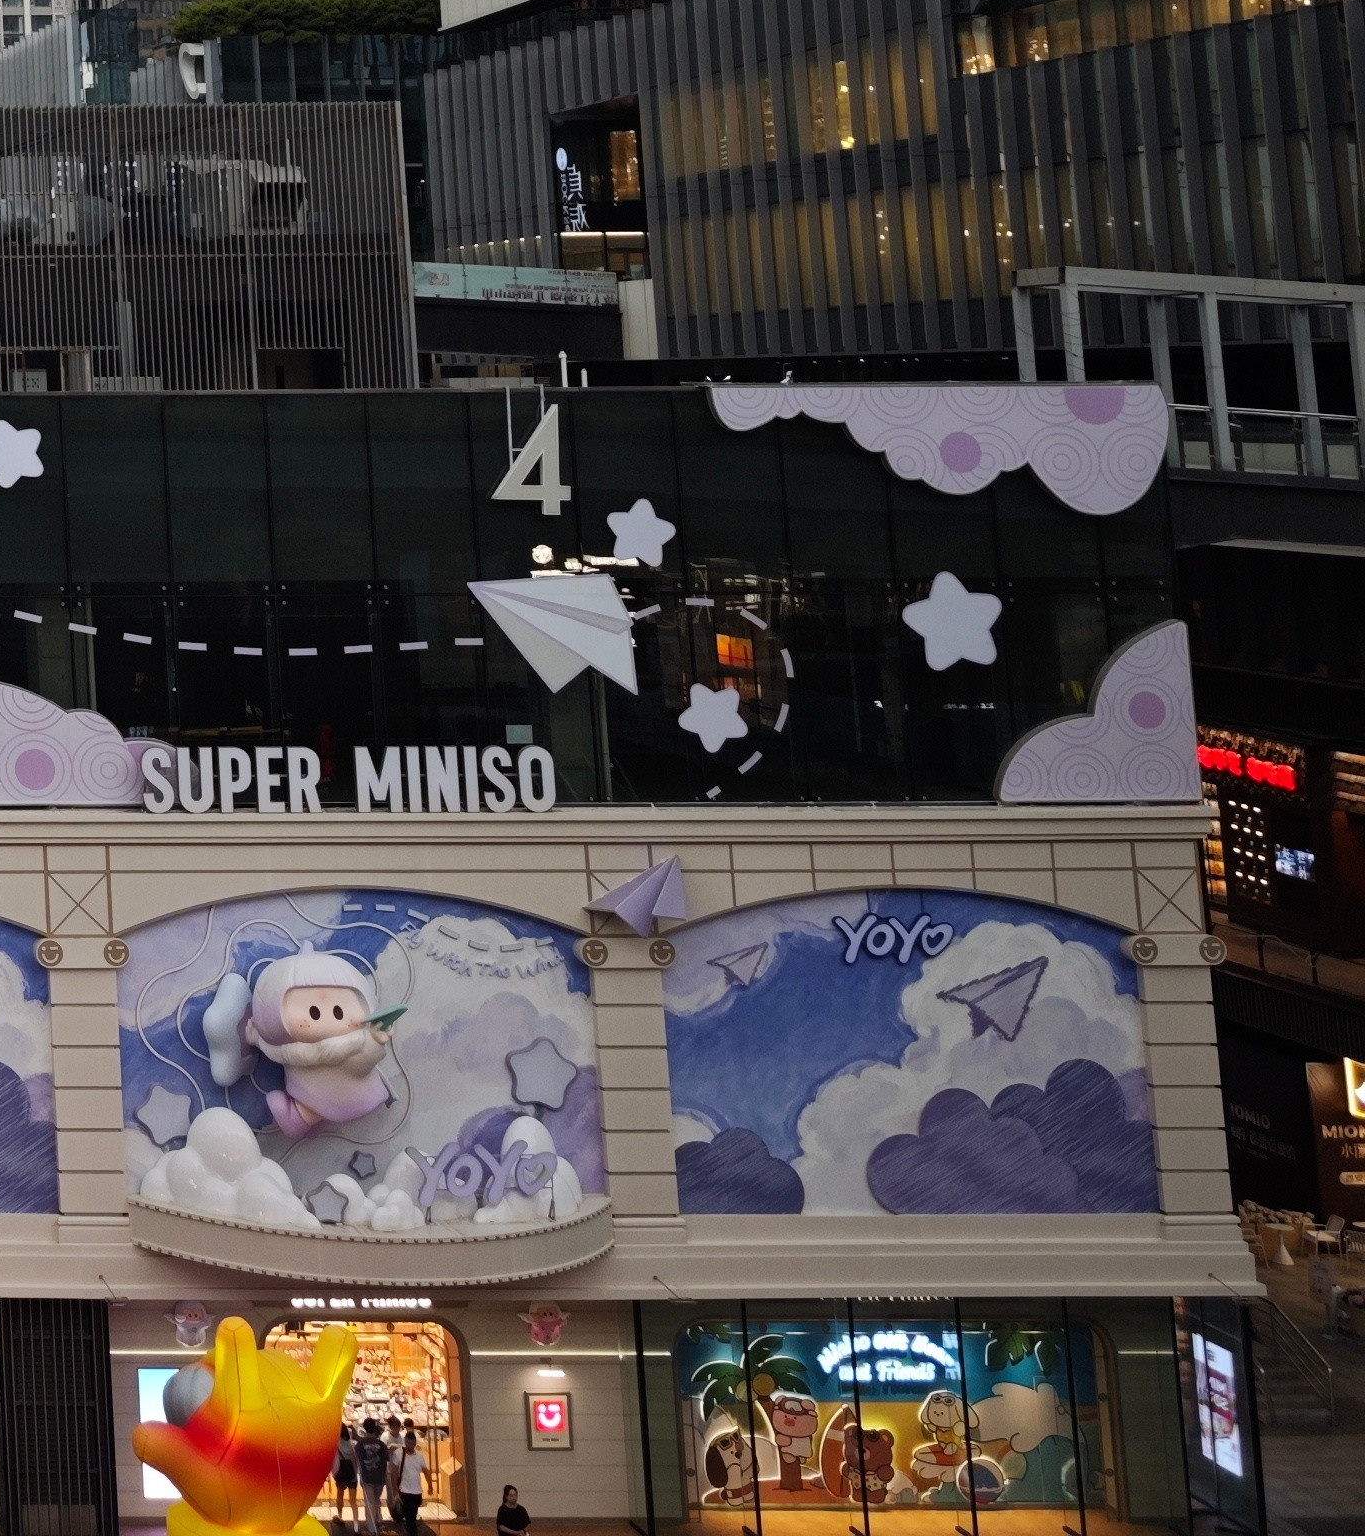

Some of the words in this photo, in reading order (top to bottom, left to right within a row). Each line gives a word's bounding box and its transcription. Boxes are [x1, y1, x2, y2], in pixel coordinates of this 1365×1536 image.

[492, 403, 572, 516] 4
[141, 745, 322, 814] SUPER
[356, 745, 557, 814] MINISO
